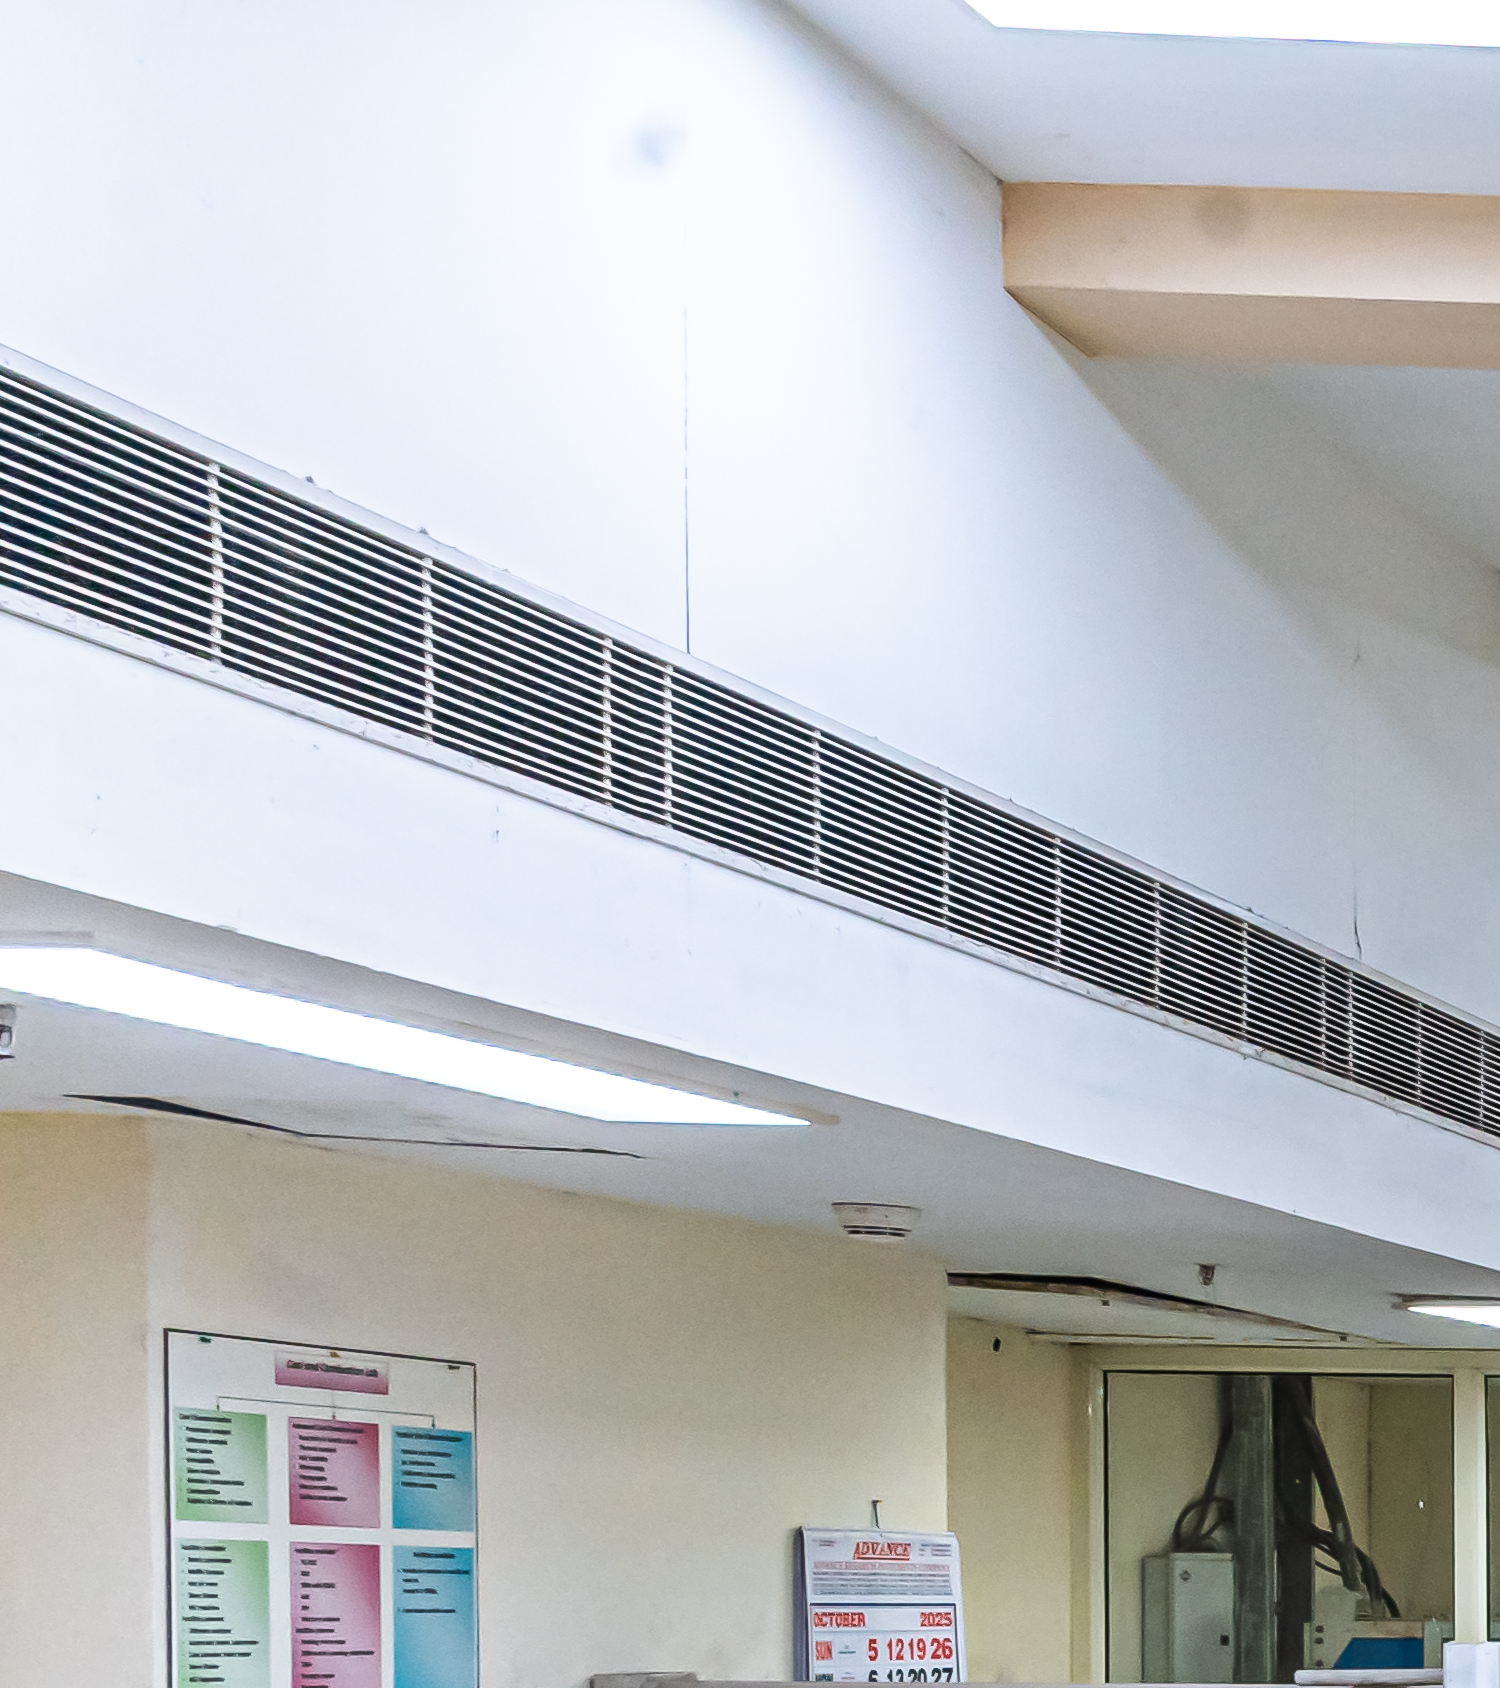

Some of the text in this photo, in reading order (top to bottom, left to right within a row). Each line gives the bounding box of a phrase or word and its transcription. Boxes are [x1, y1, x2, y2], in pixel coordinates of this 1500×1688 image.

[853, 1541, 911, 1560] ADVANCE
[813, 1612, 952, 1628] OCTOBER 2025
[868, 1638, 878, 1661] 5
[887, 1638, 904, 1661] 12
[908, 1638, 926, 1660] 19
[930, 1637, 953, 1660] 26
